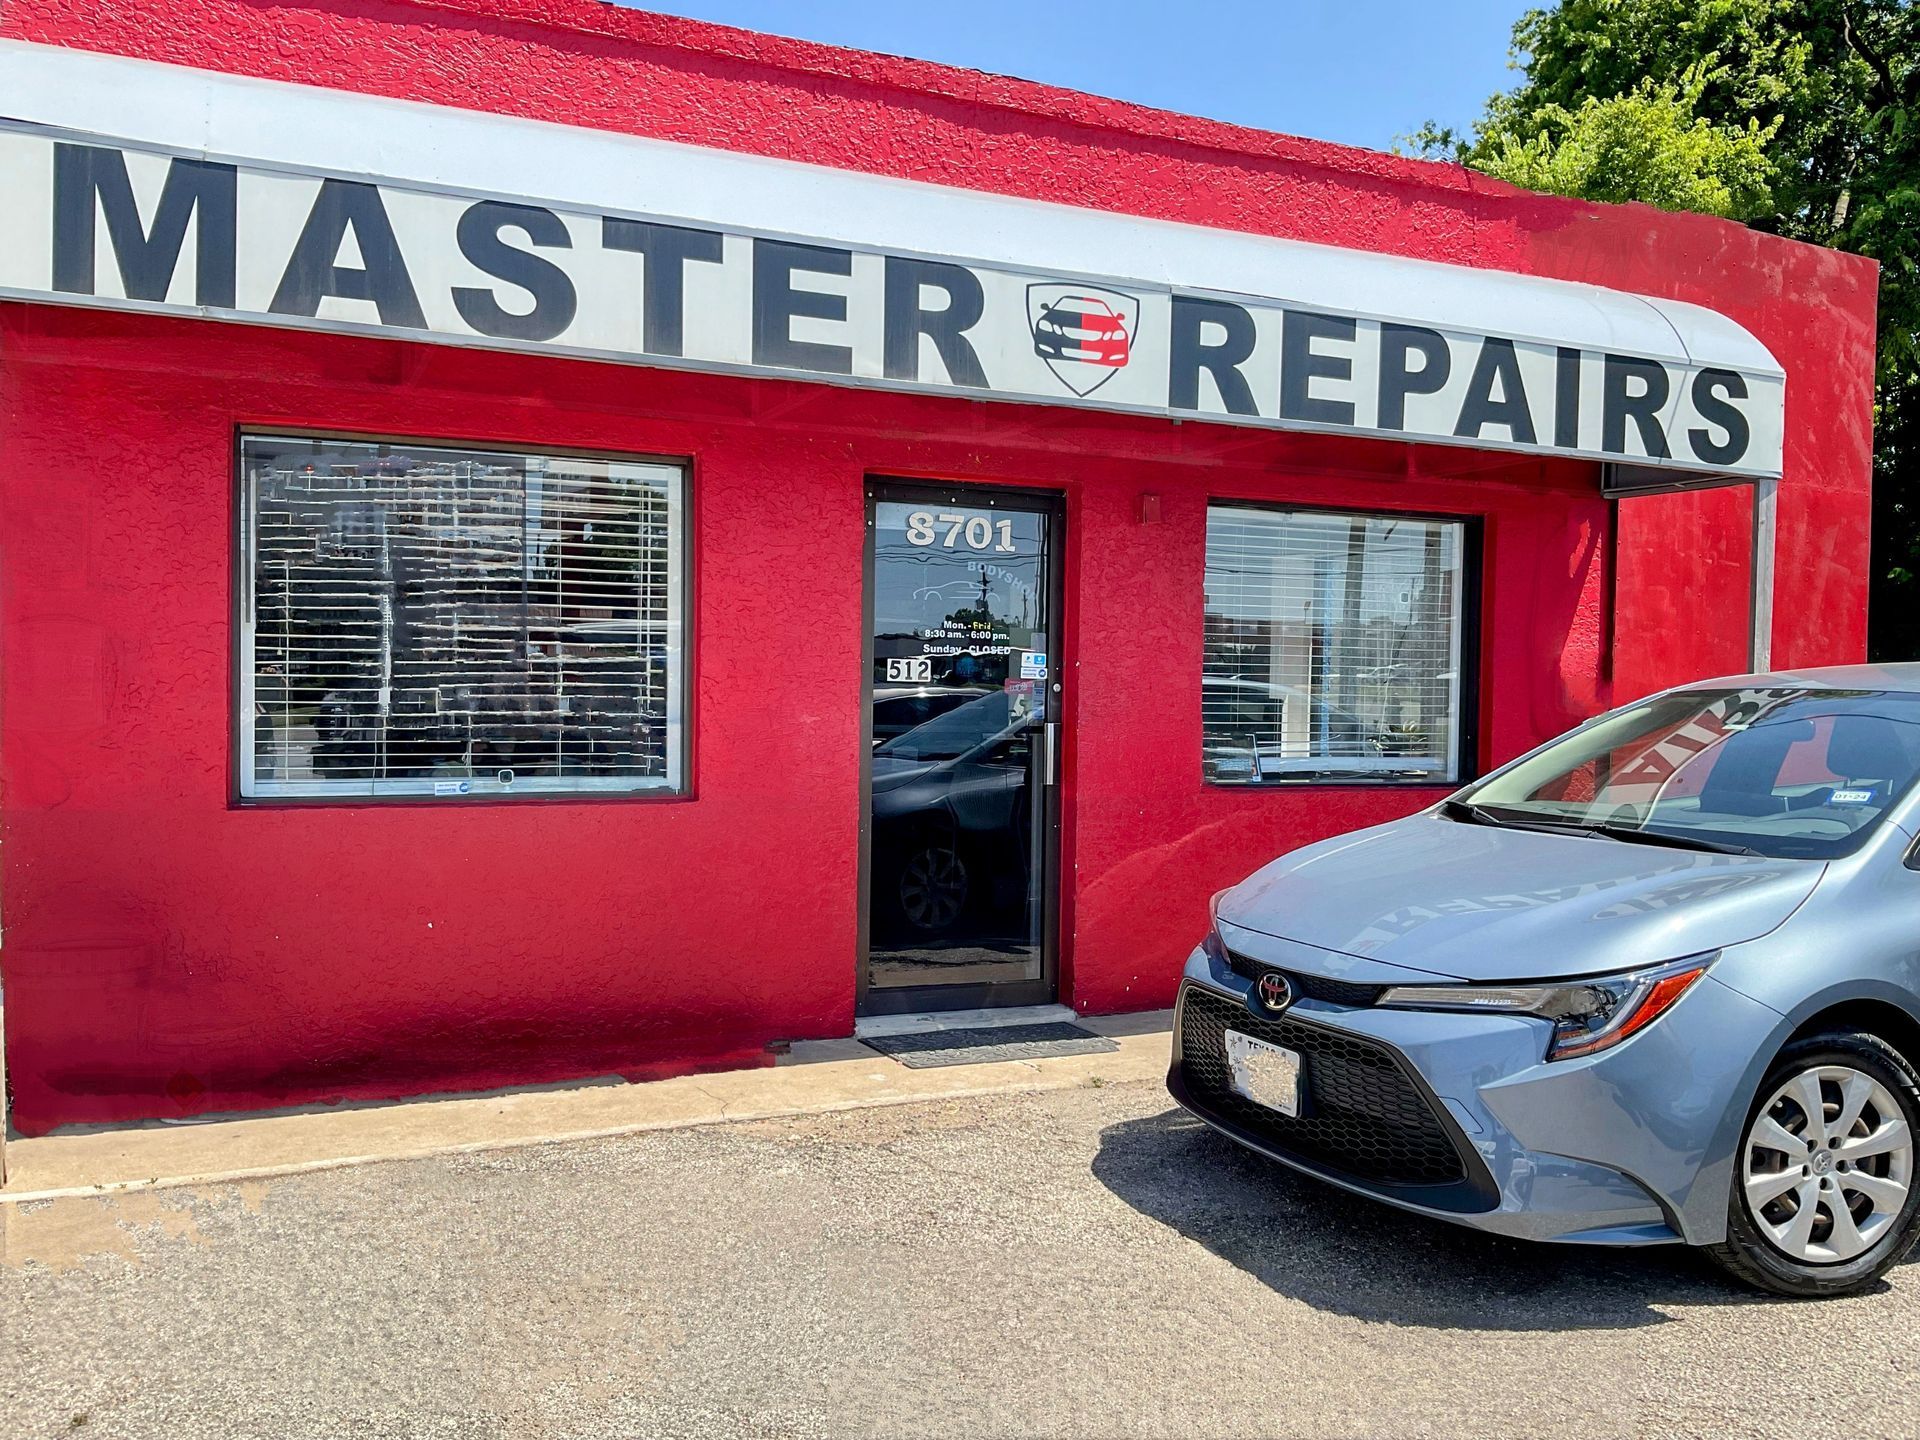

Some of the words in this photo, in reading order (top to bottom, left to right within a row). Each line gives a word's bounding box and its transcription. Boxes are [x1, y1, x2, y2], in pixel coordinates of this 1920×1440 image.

[52, 141, 991, 389] MASTER
[1168, 295, 1750, 465] REPAIRS
[906, 511, 1016, 552] 8701
[943, 621, 967, 630] Mon.
[924, 629, 946, 638] 8:30
[946, 631, 965, 639] am.
[970, 632, 991, 640] 6:00
[992, 633, 1009, 641] pm.
[922, 644, 962, 655] Sunday
[968, 645, 1011, 655] CLOSED
[888, 660, 929, 681] 512
